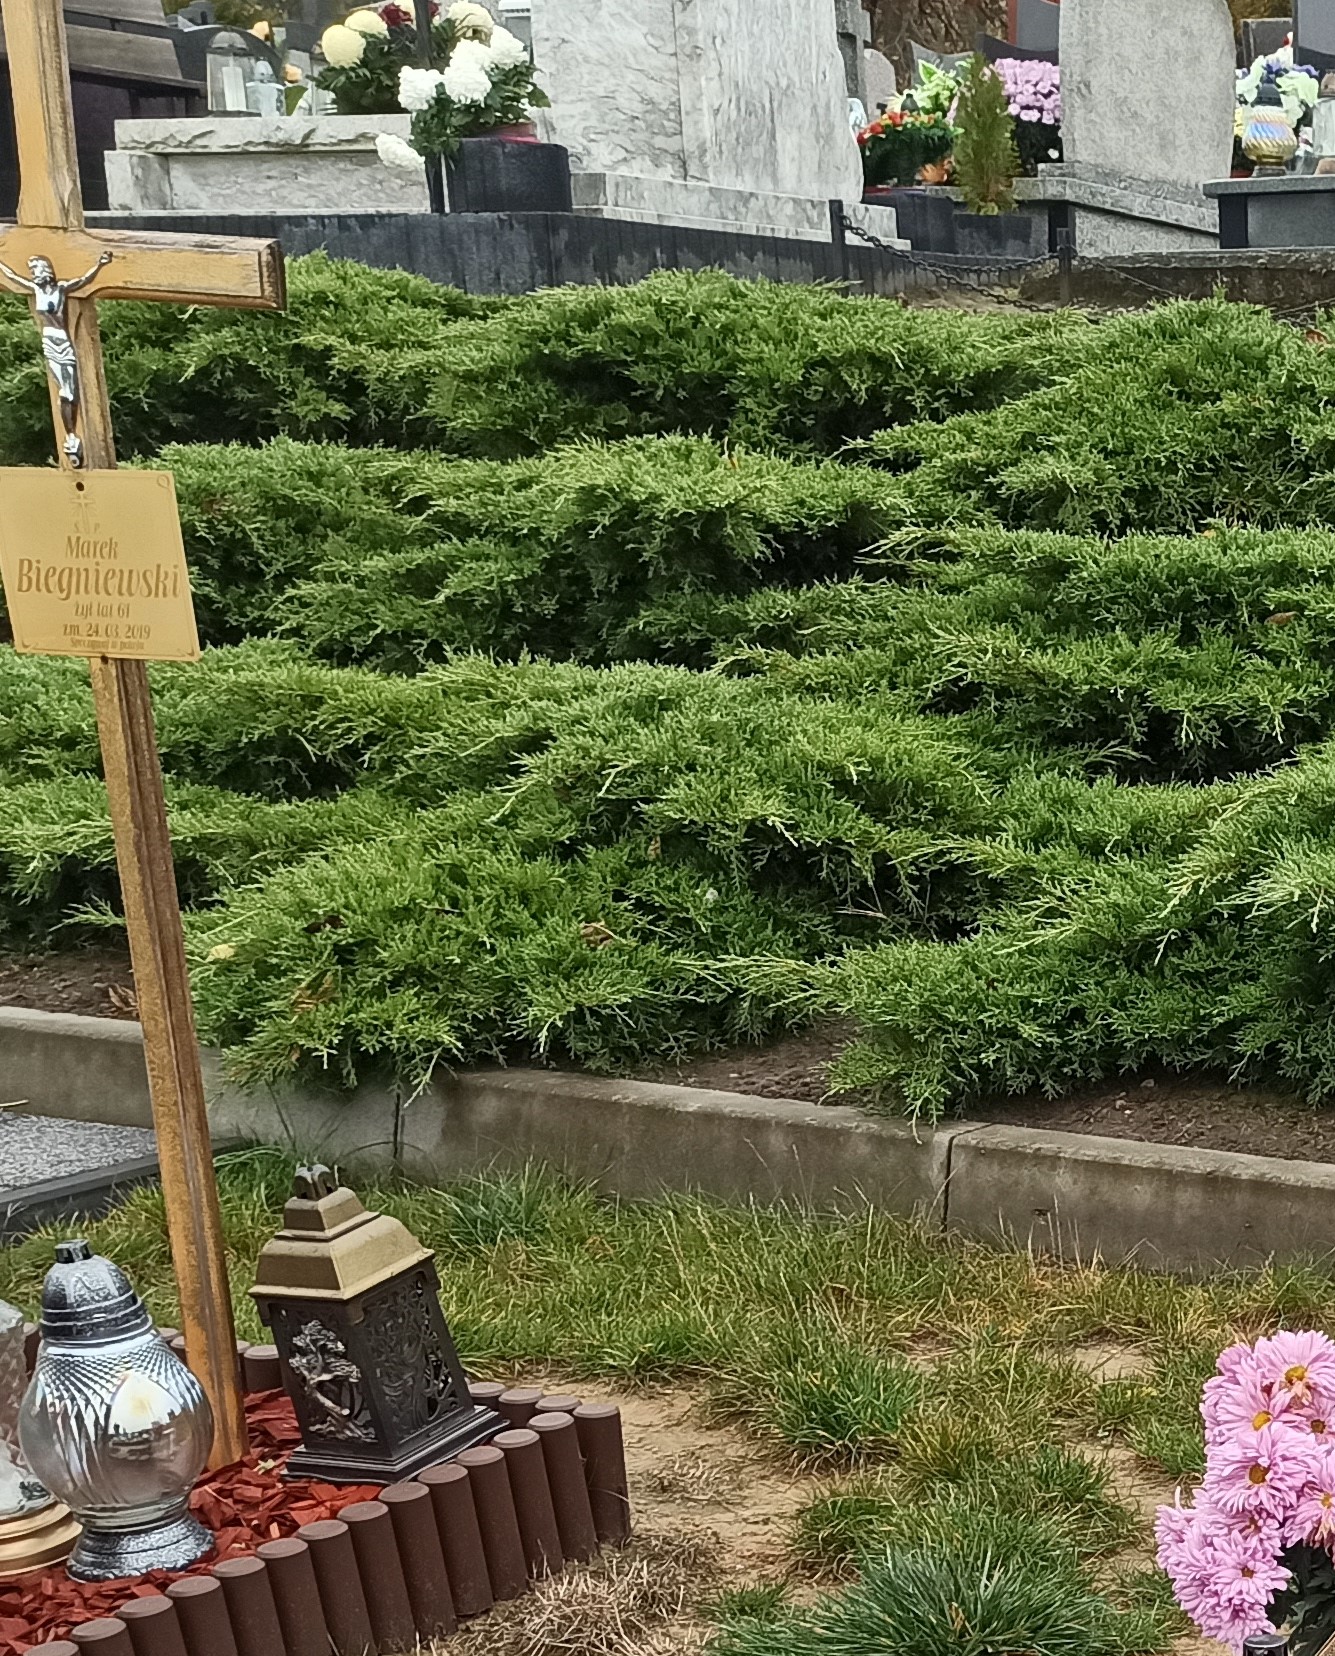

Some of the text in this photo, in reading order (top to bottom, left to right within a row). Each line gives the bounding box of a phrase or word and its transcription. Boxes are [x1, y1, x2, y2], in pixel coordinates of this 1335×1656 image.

[65, 535, 119, 560] Marek
[17, 558, 180, 601] Biegniewski
[117, 603, 130, 618] 61
